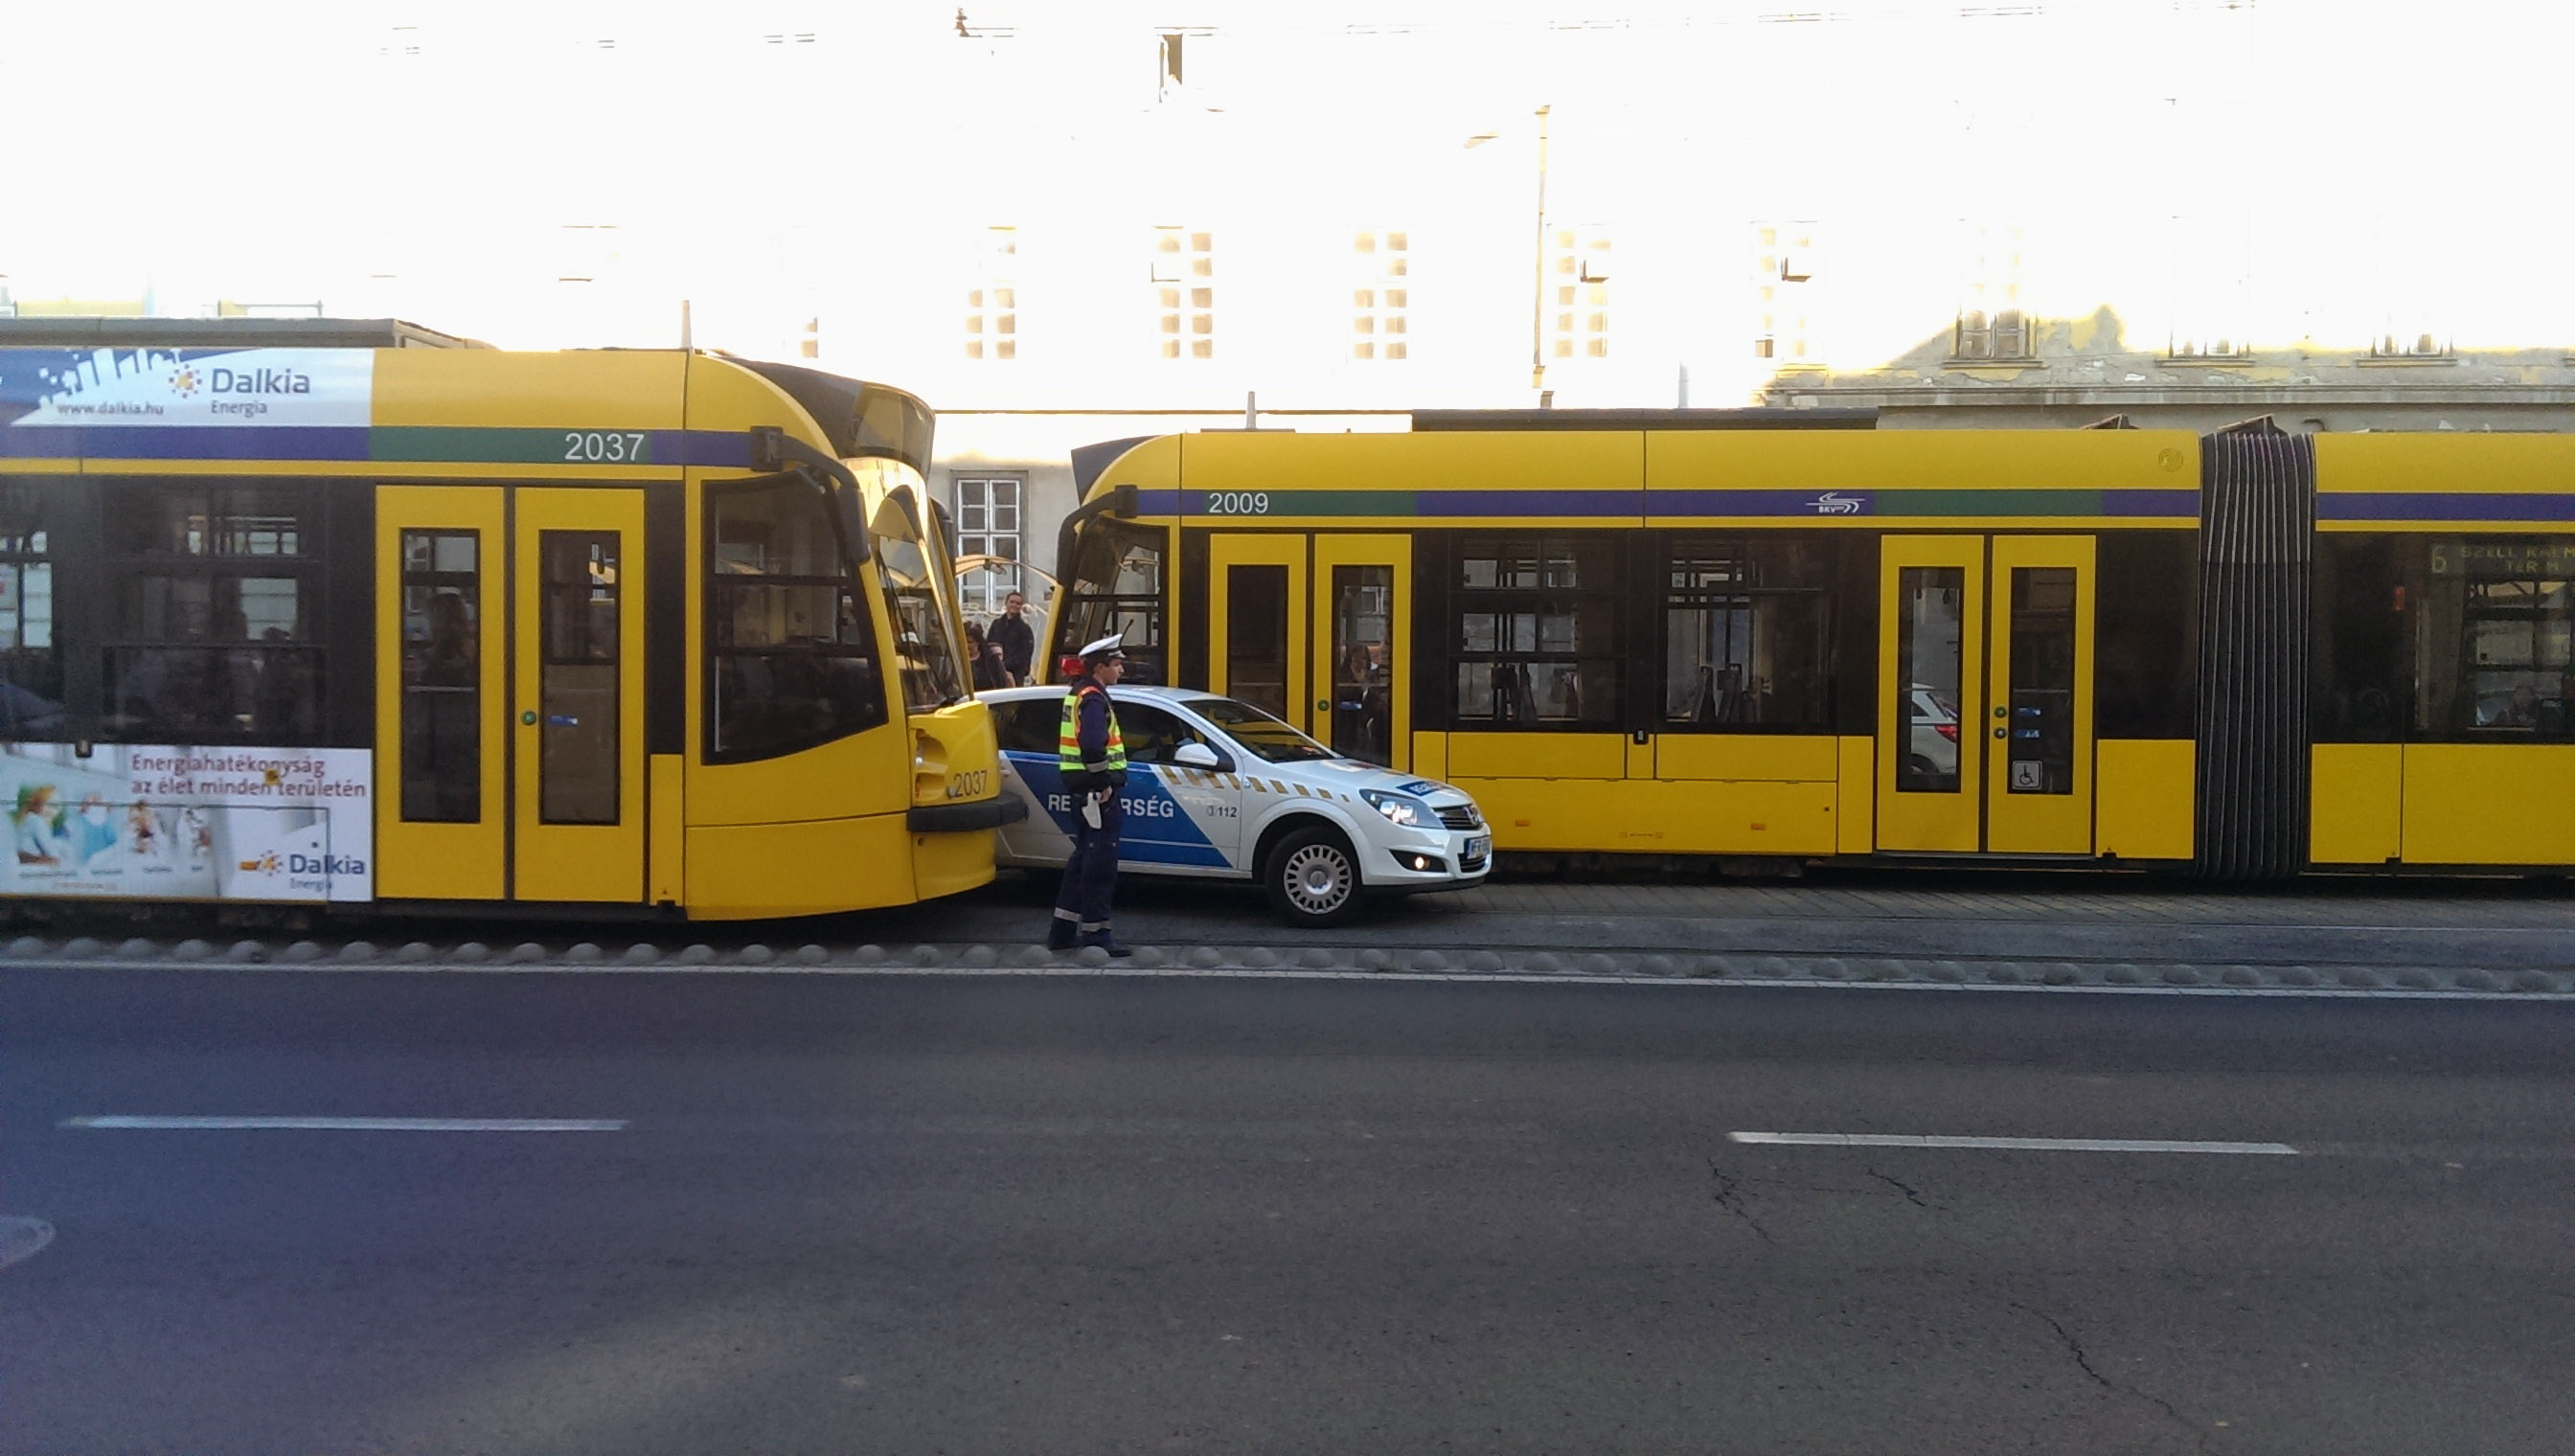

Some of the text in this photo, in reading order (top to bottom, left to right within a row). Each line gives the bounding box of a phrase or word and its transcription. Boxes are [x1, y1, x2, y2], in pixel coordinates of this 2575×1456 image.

[211, 368, 310, 394] Dalkia
[57, 402, 164, 415] www.dalkia.hu
[210, 400, 267, 418] Energia
[564, 432, 645, 461] 2037
[1208, 492, 1269, 513] 2009
[131, 753, 326, 778] Energiahatékonyság
[131, 776, 366, 798] az élet minden területén
[953, 769, 988, 797] 2037
[1218, 806, 1238, 818] 112
[289, 853, 365, 876] Dalkia
